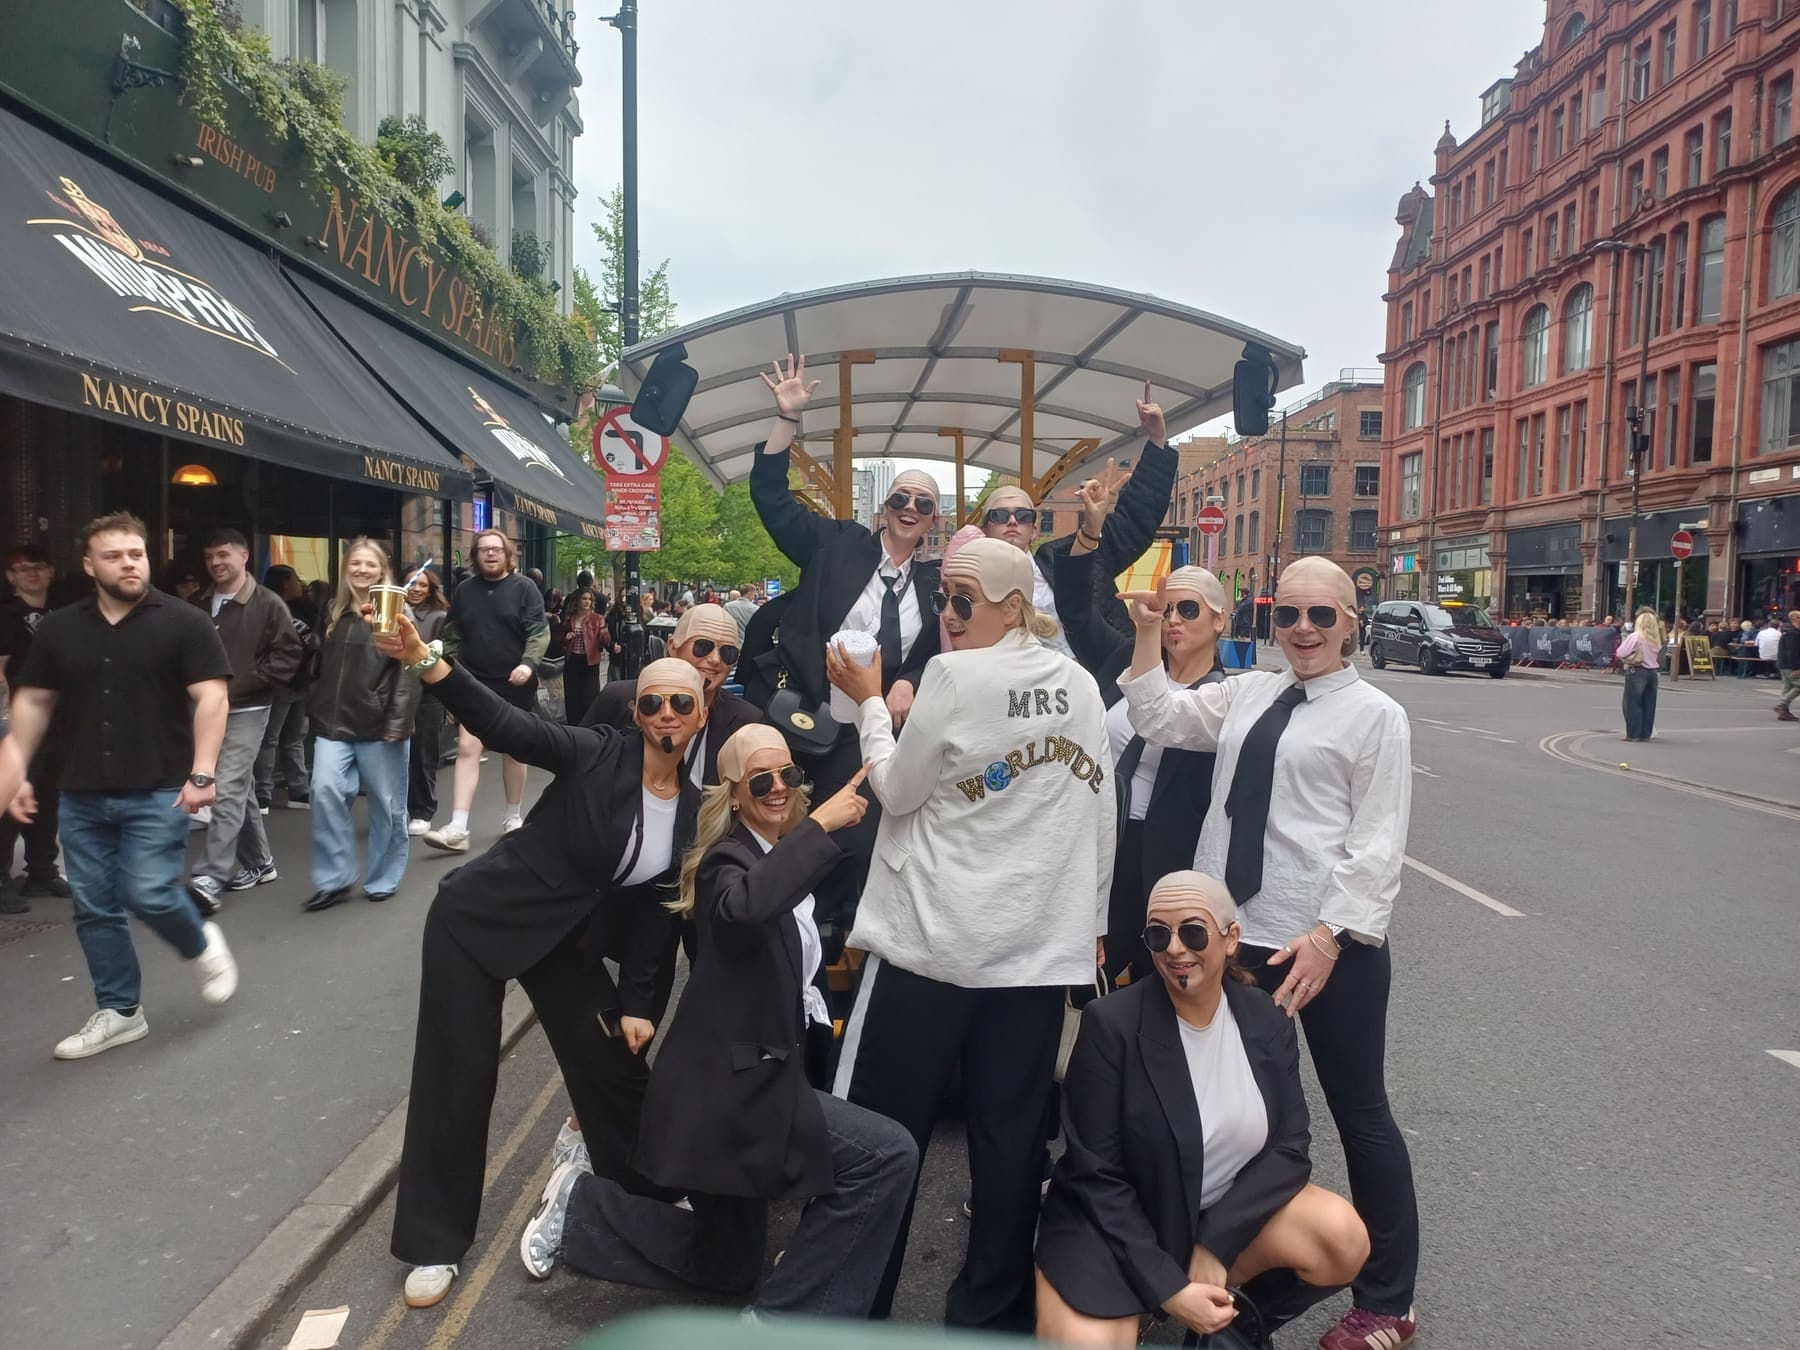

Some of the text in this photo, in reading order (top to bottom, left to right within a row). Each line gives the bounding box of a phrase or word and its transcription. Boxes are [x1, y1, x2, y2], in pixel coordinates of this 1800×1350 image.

[196, 123, 277, 193] IRISH PUB
[320, 184, 447, 318] NANCY
[81, 372, 245, 446] NANCY SPAINS
[364, 455, 441, 492] NANCY SPAINS
[1008, 688, 1069, 718] MRS
[956, 735, 1104, 802] WORLDWIDE
